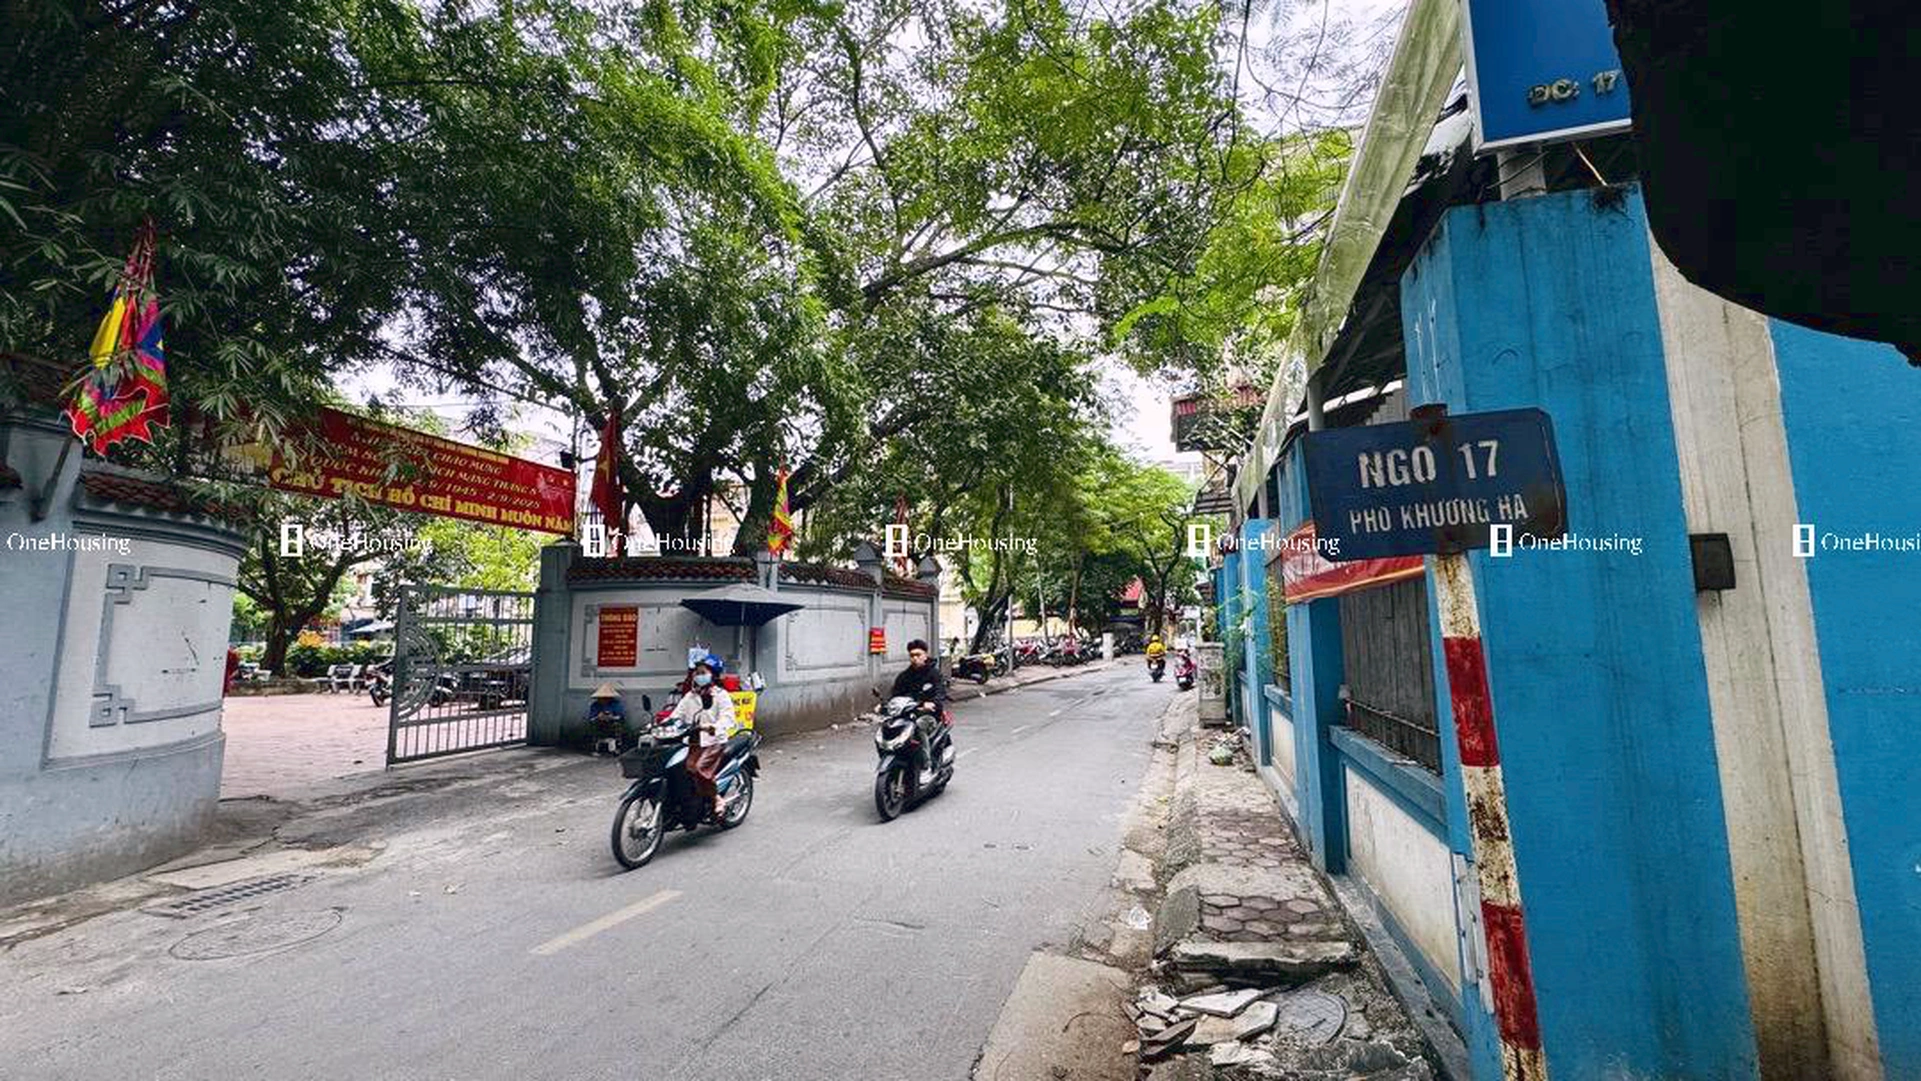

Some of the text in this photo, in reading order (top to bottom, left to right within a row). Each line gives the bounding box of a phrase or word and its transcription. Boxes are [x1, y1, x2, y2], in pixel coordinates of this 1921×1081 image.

[1457, 439, 1499, 480] 17
[454, 499, 498, 519] MINH
[500, 508, 542, 527] MUÔN
